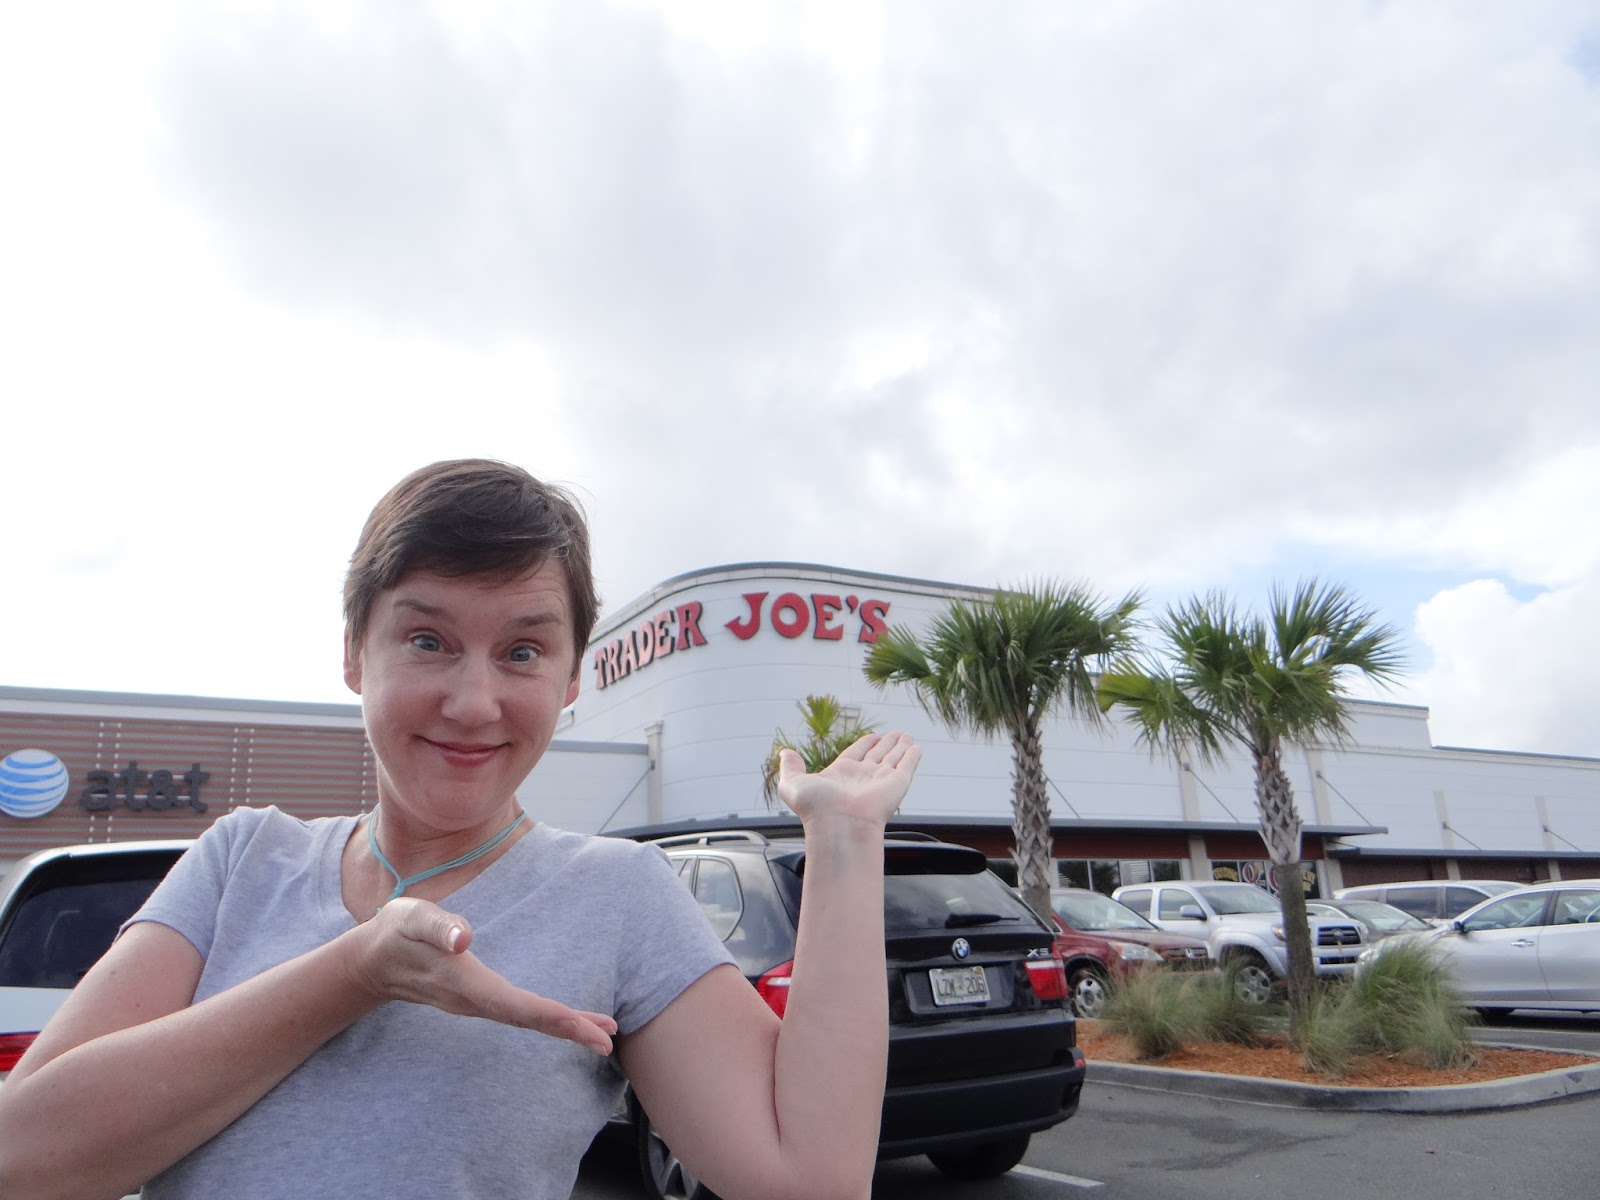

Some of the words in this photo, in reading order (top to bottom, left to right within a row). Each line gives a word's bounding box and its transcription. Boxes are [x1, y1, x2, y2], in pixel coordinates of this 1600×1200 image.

[594, 601, 708, 689] TRADER
[724, 592, 891, 643] JOE'S
[82, 760, 210, 812] at&t
